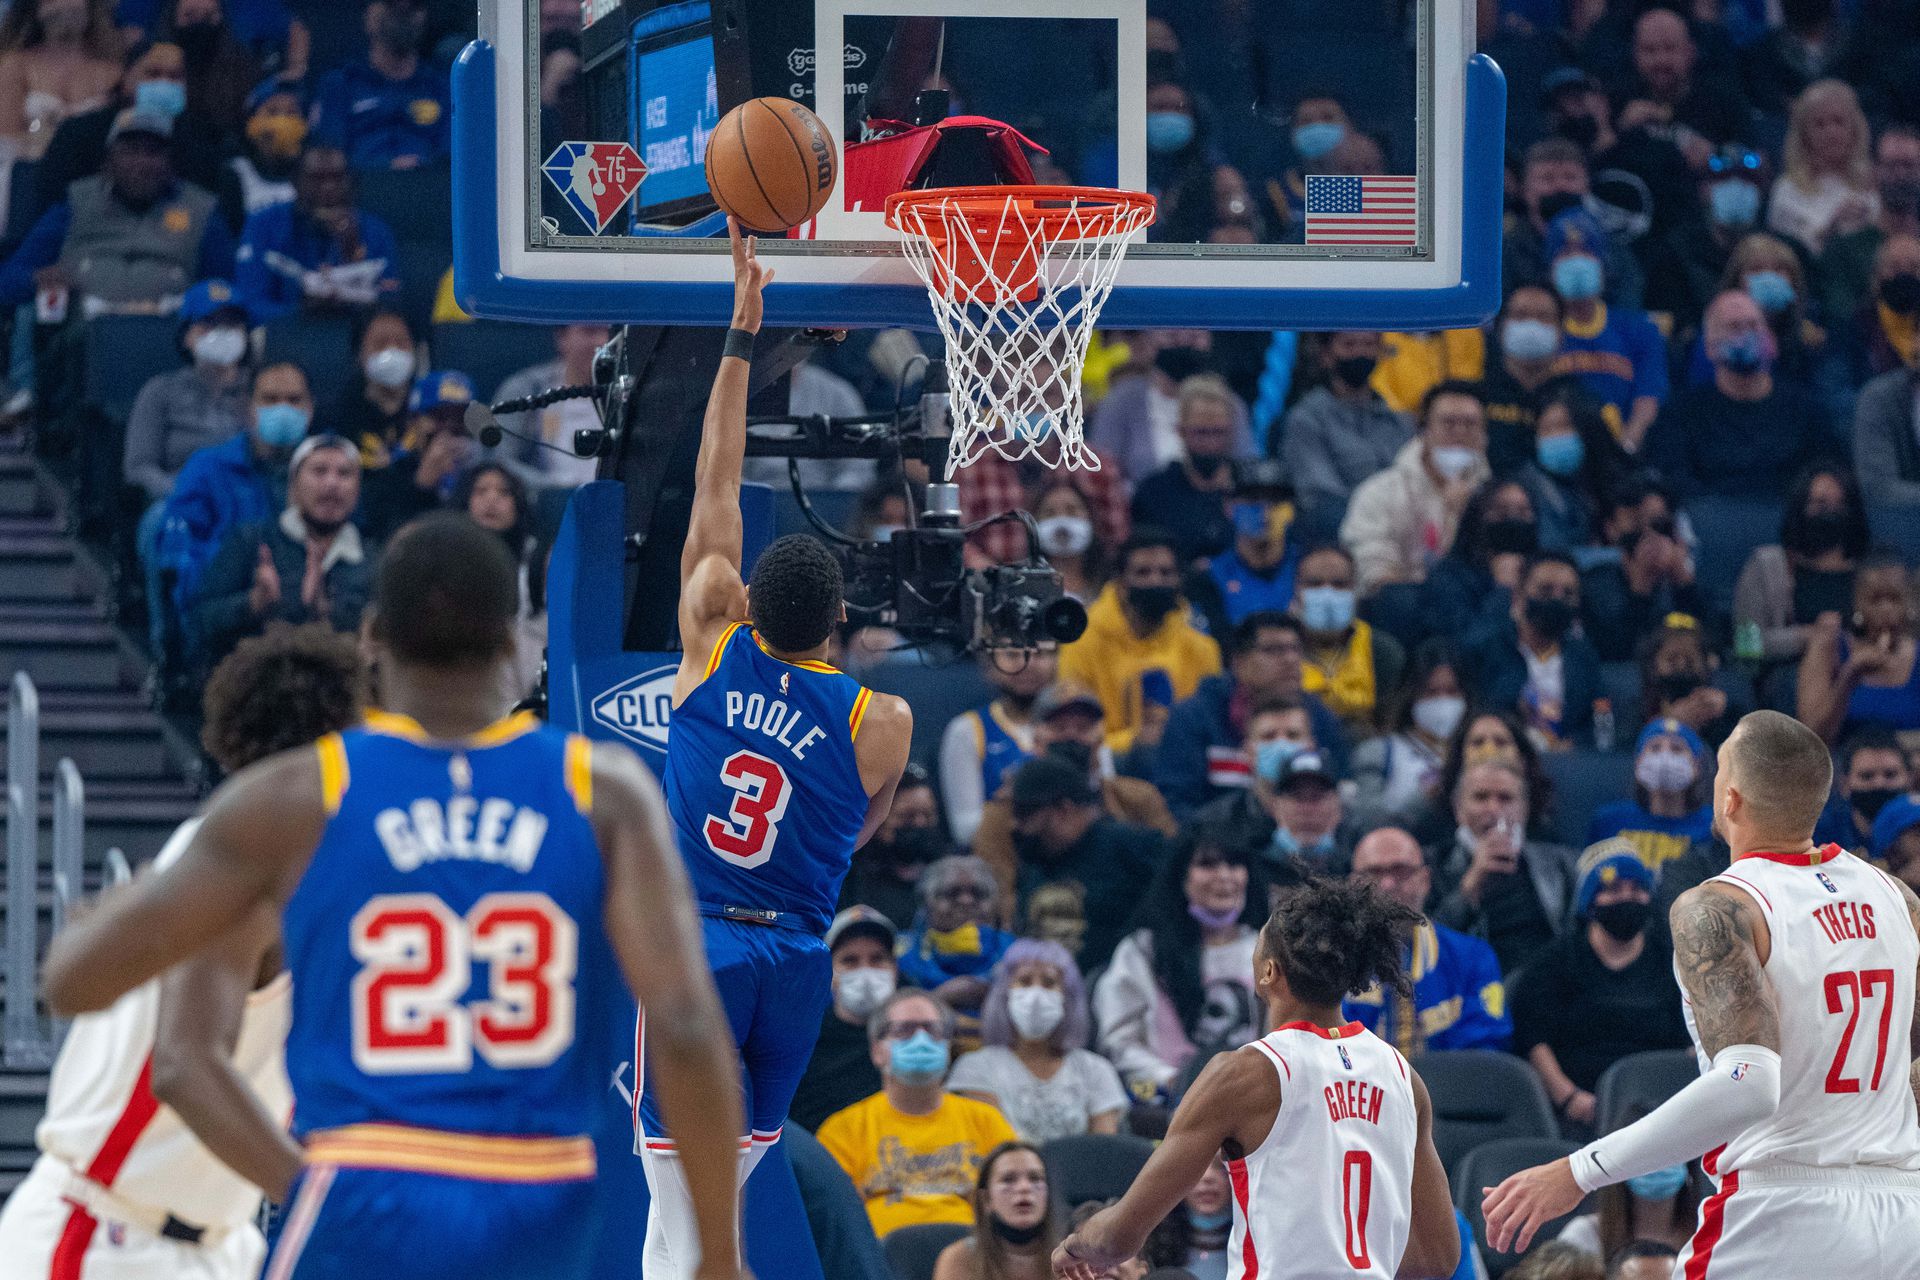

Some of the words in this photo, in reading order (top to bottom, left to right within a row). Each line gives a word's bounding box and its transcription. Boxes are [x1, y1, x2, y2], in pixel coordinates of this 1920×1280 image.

[606, 156, 626, 183] 75
[617, 694, 673, 727] CLO
[726, 690, 827, 761] POOLE
[373, 796, 549, 874] GREEN
[702, 749, 793, 870] 3
[1812, 901, 1877, 945] THEIS
[350, 891, 579, 1076] 23
[1823, 968, 1895, 1094] 27
[1323, 1080, 1384, 1126] GREEN
[1342, 1150, 1372, 1270] 0
